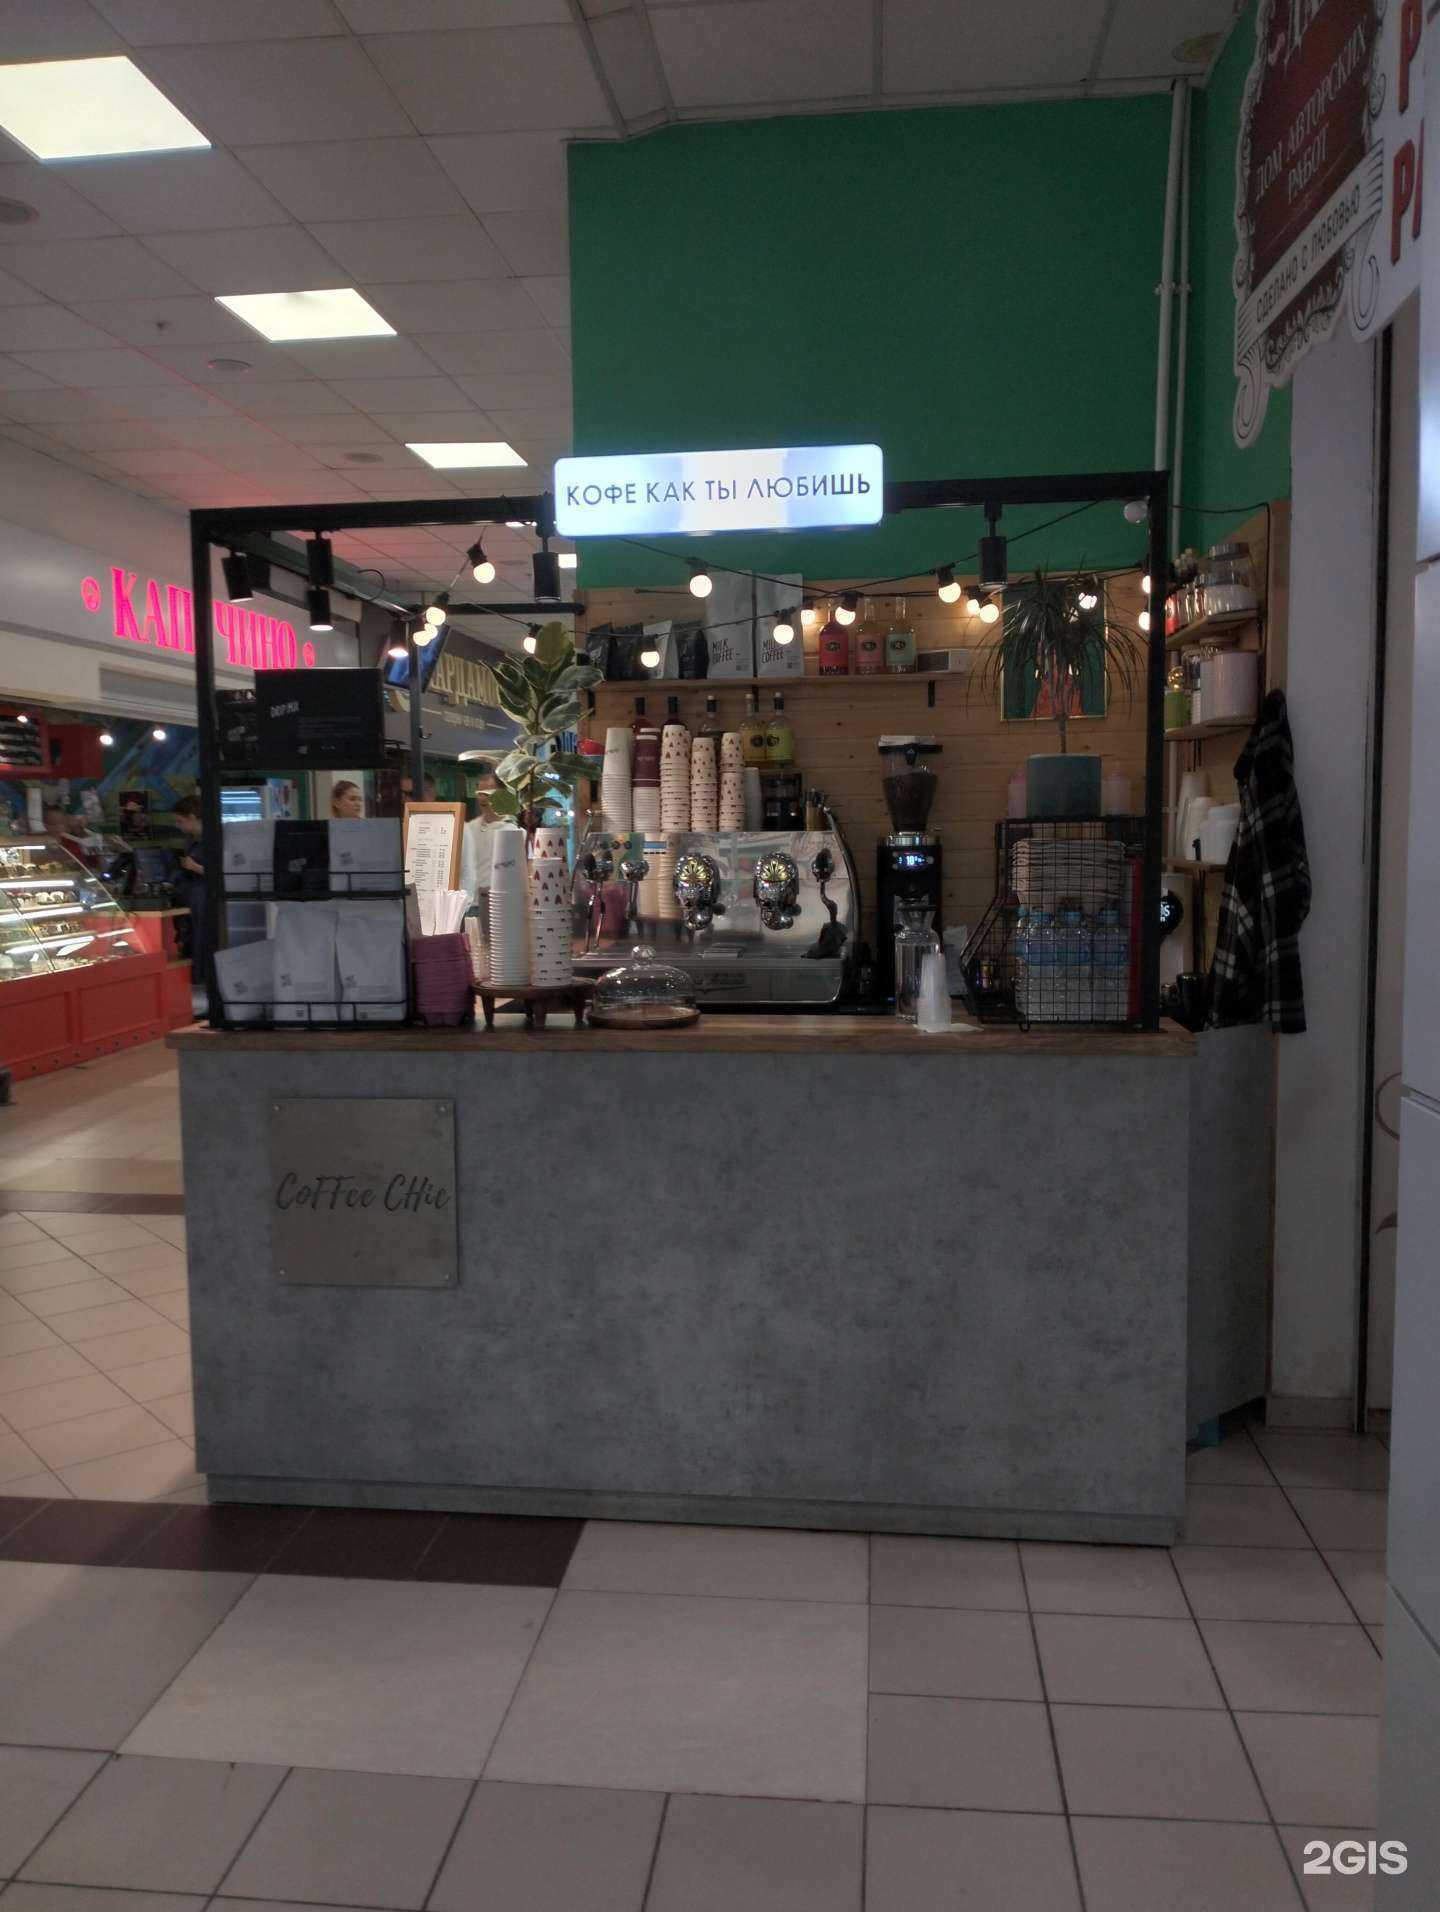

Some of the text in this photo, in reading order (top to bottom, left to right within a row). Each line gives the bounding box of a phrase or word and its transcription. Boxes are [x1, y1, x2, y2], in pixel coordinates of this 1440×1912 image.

[1255, 141, 1283, 201] ДОМ
[1288, 19, 1367, 155] АВТОРСКИХ
[1288, 126, 1329, 204] РАБОТ
[1256, 255, 1298, 323] СДЕЛАНО
[1301, 243, 1309, 271] С
[1311, 185, 1360, 257] ЛЮБОВЬЮ
[567, 472, 871, 506] КОФЕ КАК ТЫ ЛЮБИШЬ
[111, 566, 298, 670] КАПЧИНО
[761, 646, 784, 664] COFFEE
